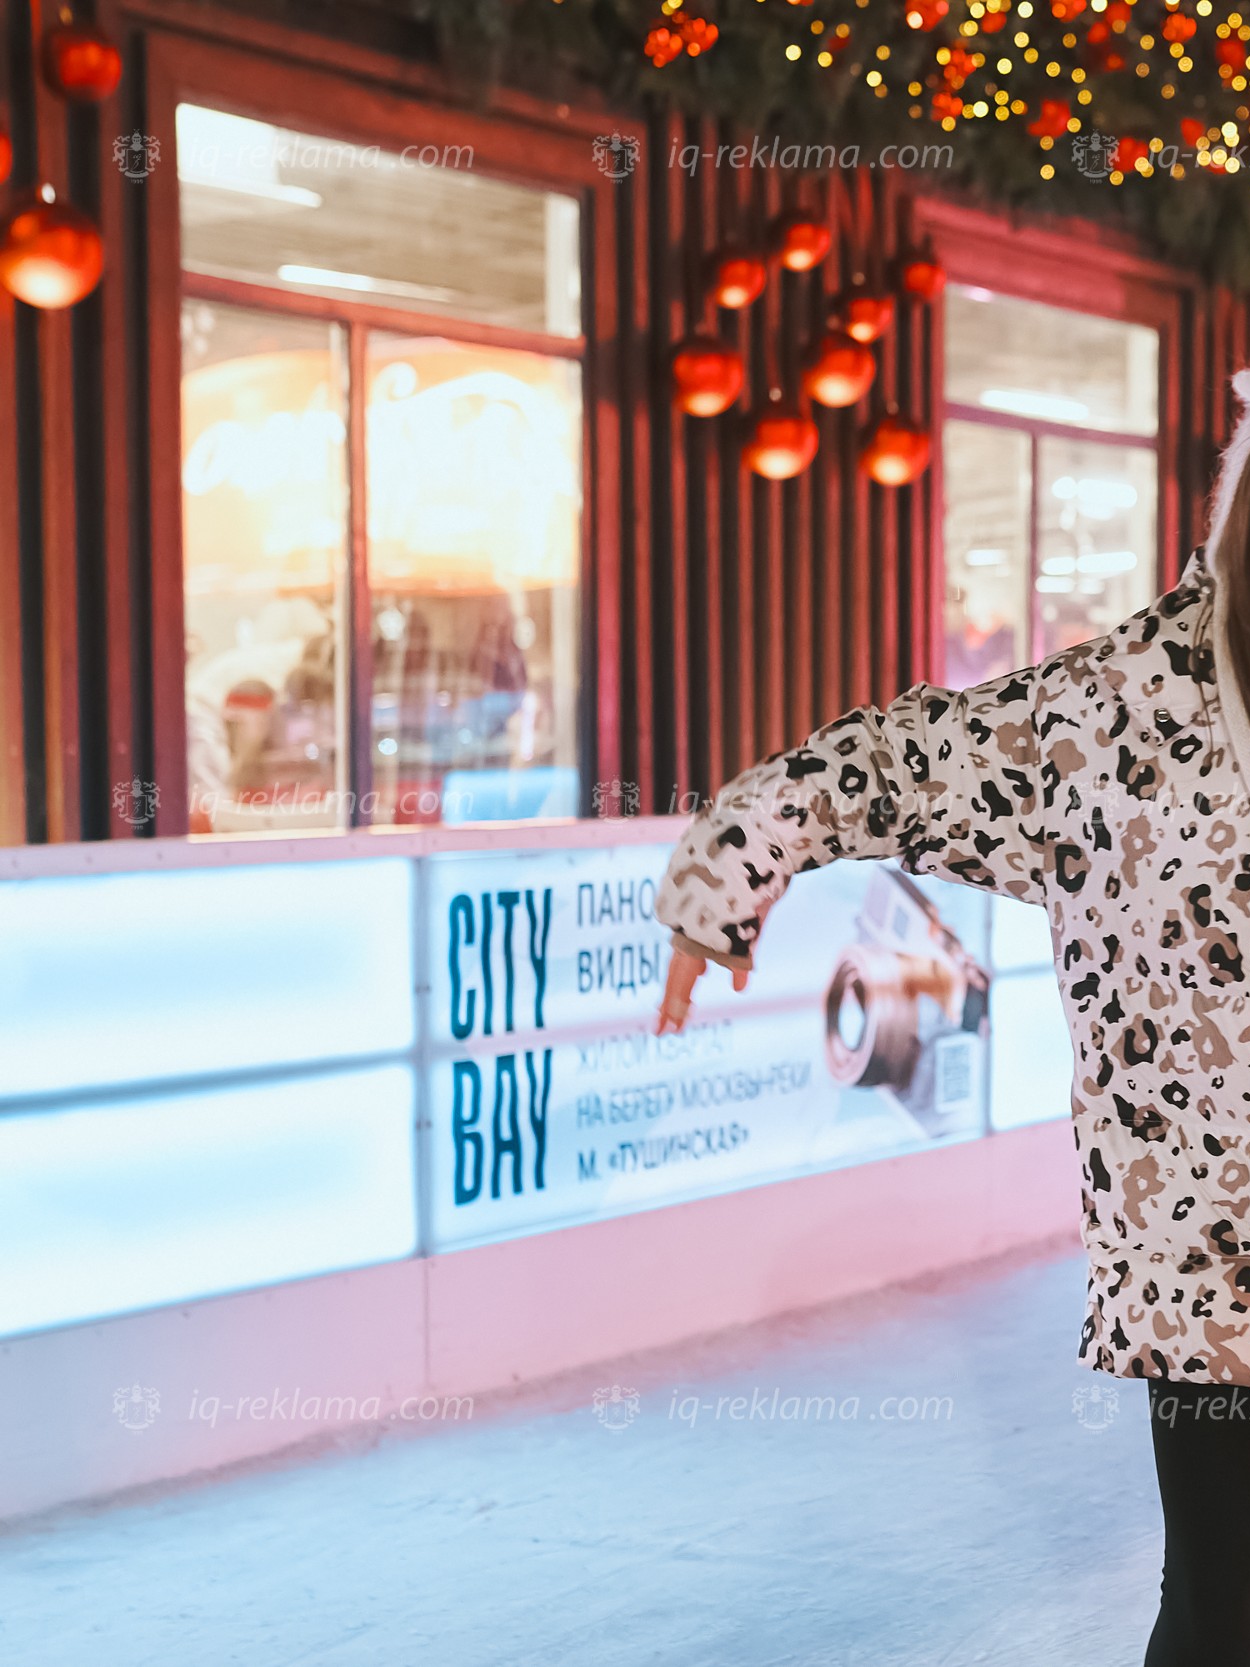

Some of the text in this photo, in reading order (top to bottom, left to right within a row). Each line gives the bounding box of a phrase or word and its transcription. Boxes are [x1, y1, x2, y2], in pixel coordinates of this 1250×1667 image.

[448, 888, 551, 1040] CITY
[577, 939, 660, 996] ВИДЫ
[453, 1048, 551, 1206] BAY
[576, 1092, 604, 1130] НА
[577, 1147, 602, 1182] М.
